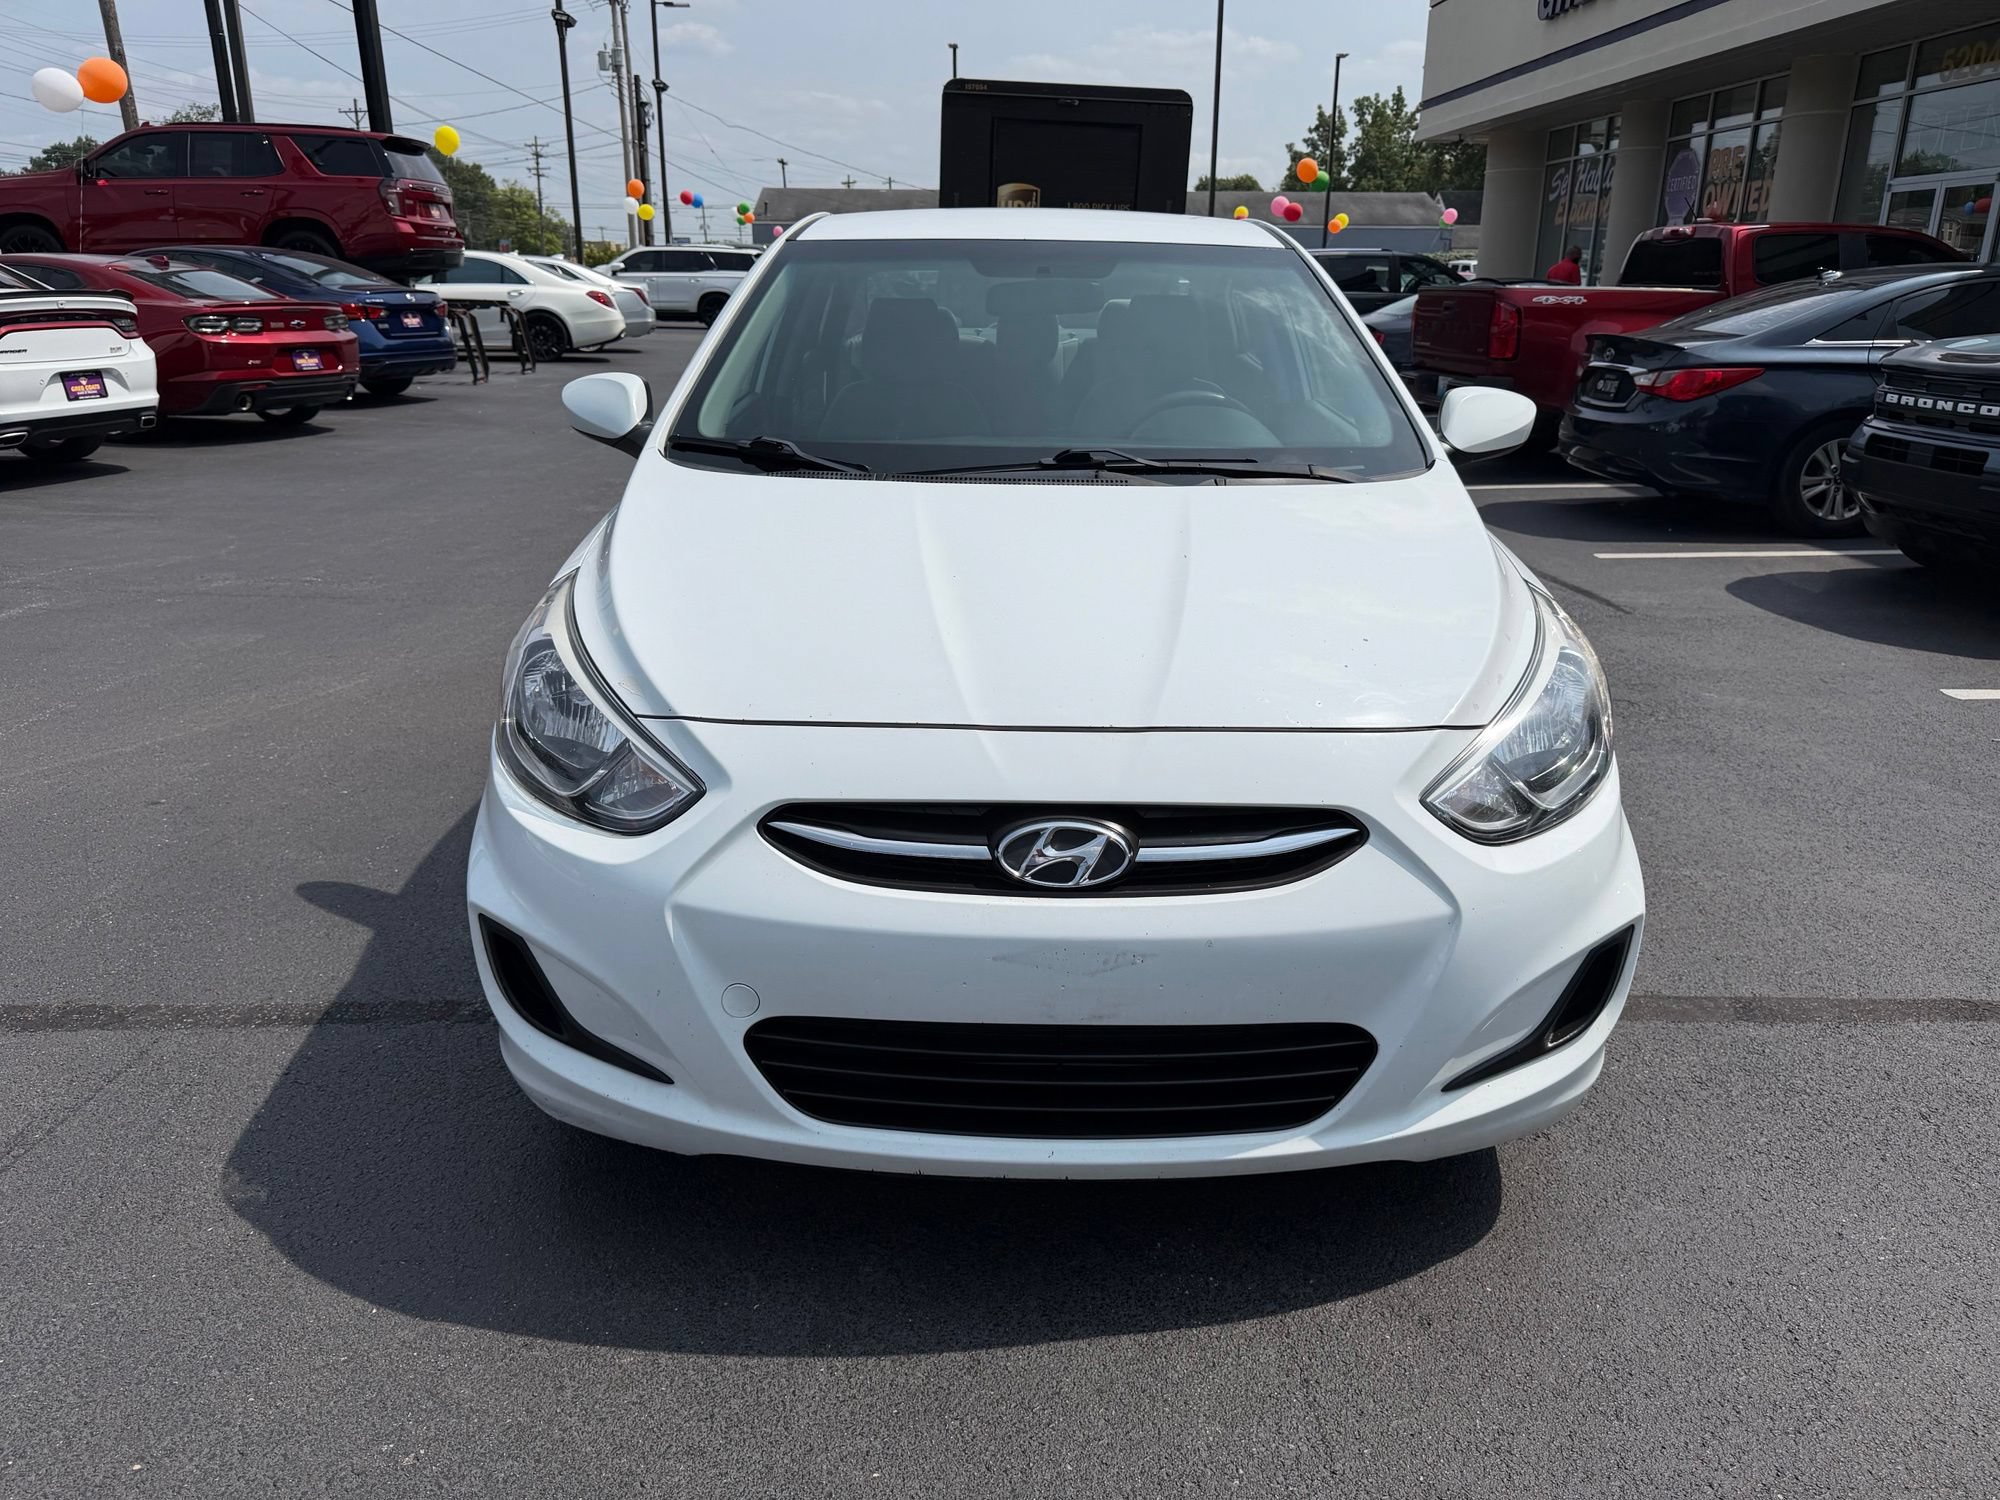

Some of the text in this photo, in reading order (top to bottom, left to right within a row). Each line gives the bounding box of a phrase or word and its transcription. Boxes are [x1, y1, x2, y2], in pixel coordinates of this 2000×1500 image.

[1709, 146, 1746, 178] PRE
[1666, 174, 1697, 193] CERTIFIED
[1885, 393, 2000, 416] BRONCO
